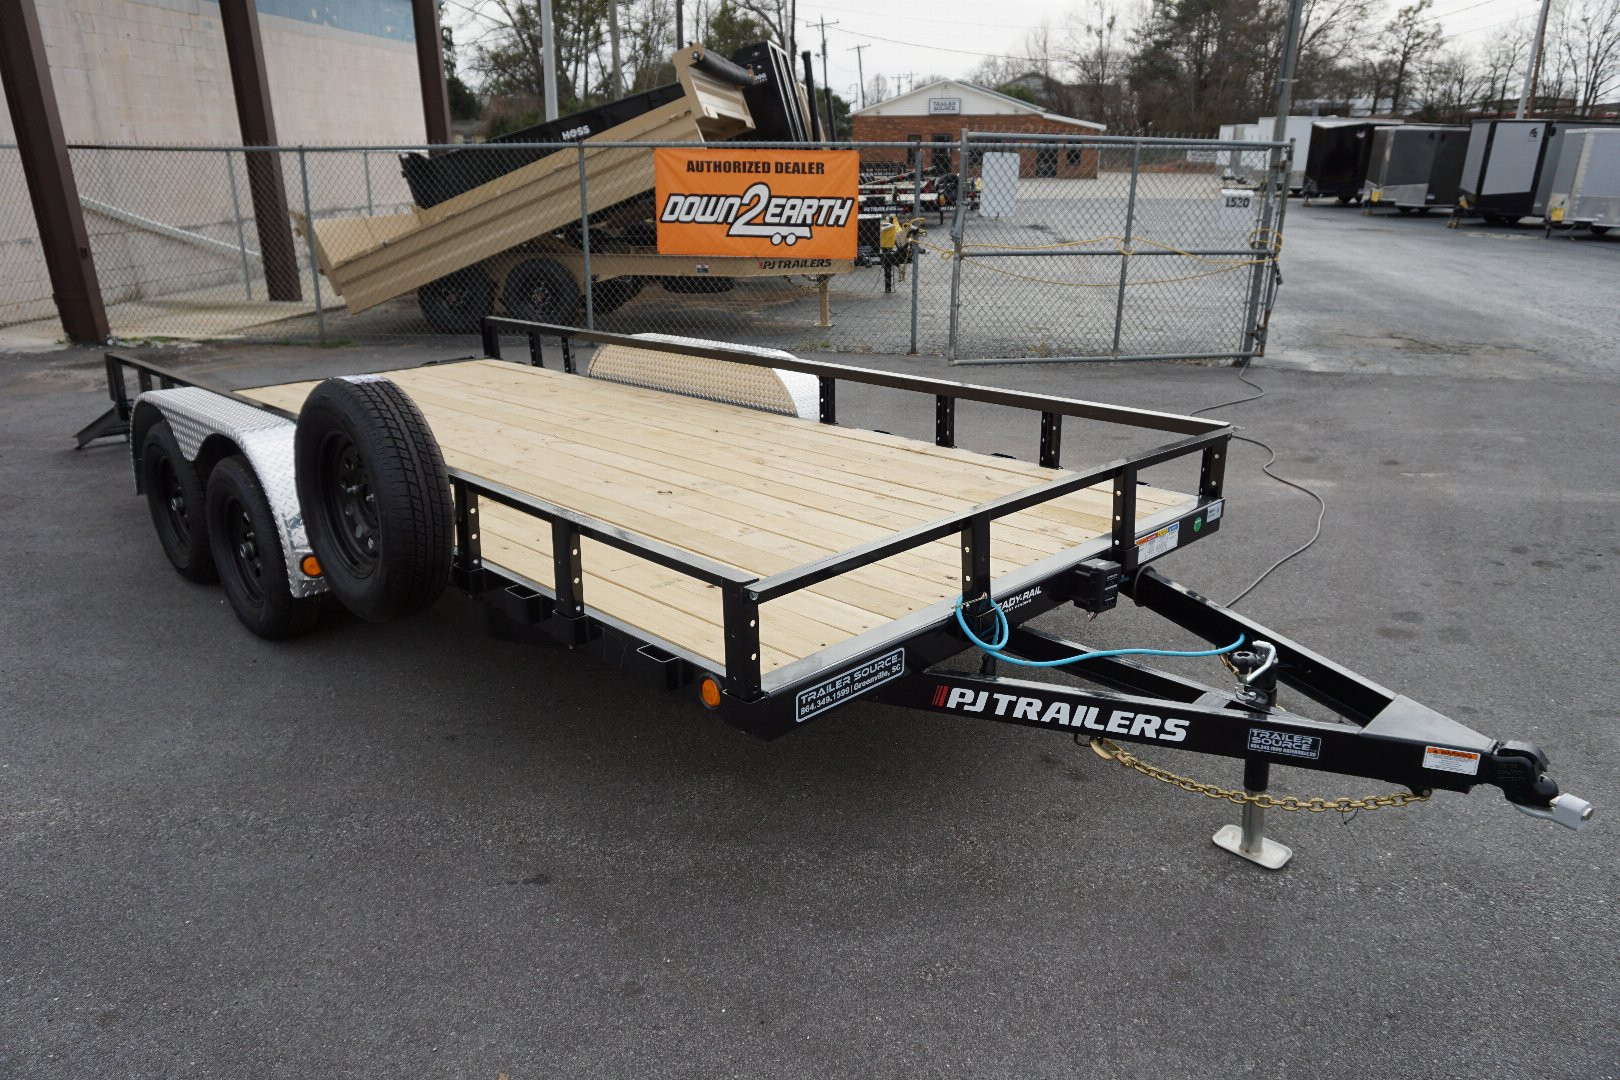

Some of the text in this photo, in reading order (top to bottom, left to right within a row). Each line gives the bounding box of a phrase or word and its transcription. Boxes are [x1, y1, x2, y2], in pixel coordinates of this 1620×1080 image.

[561, 124, 591, 140] HOSS
[687, 160, 825, 174] AUTHORIZED DEALER
[1225, 197, 1250, 208] 1520
[777, 259, 832, 268] TRAILERS
[891, 663, 901, 673] SC
[800, 654, 900, 704] TRAILER SOURCE
[946, 687, 1190, 742] PJ TRAILERS
[1251, 736, 1311, 750] SOURCE
[1252, 729, 1313, 744] TRAILER
[1440, 750, 1473, 759] WARNING
